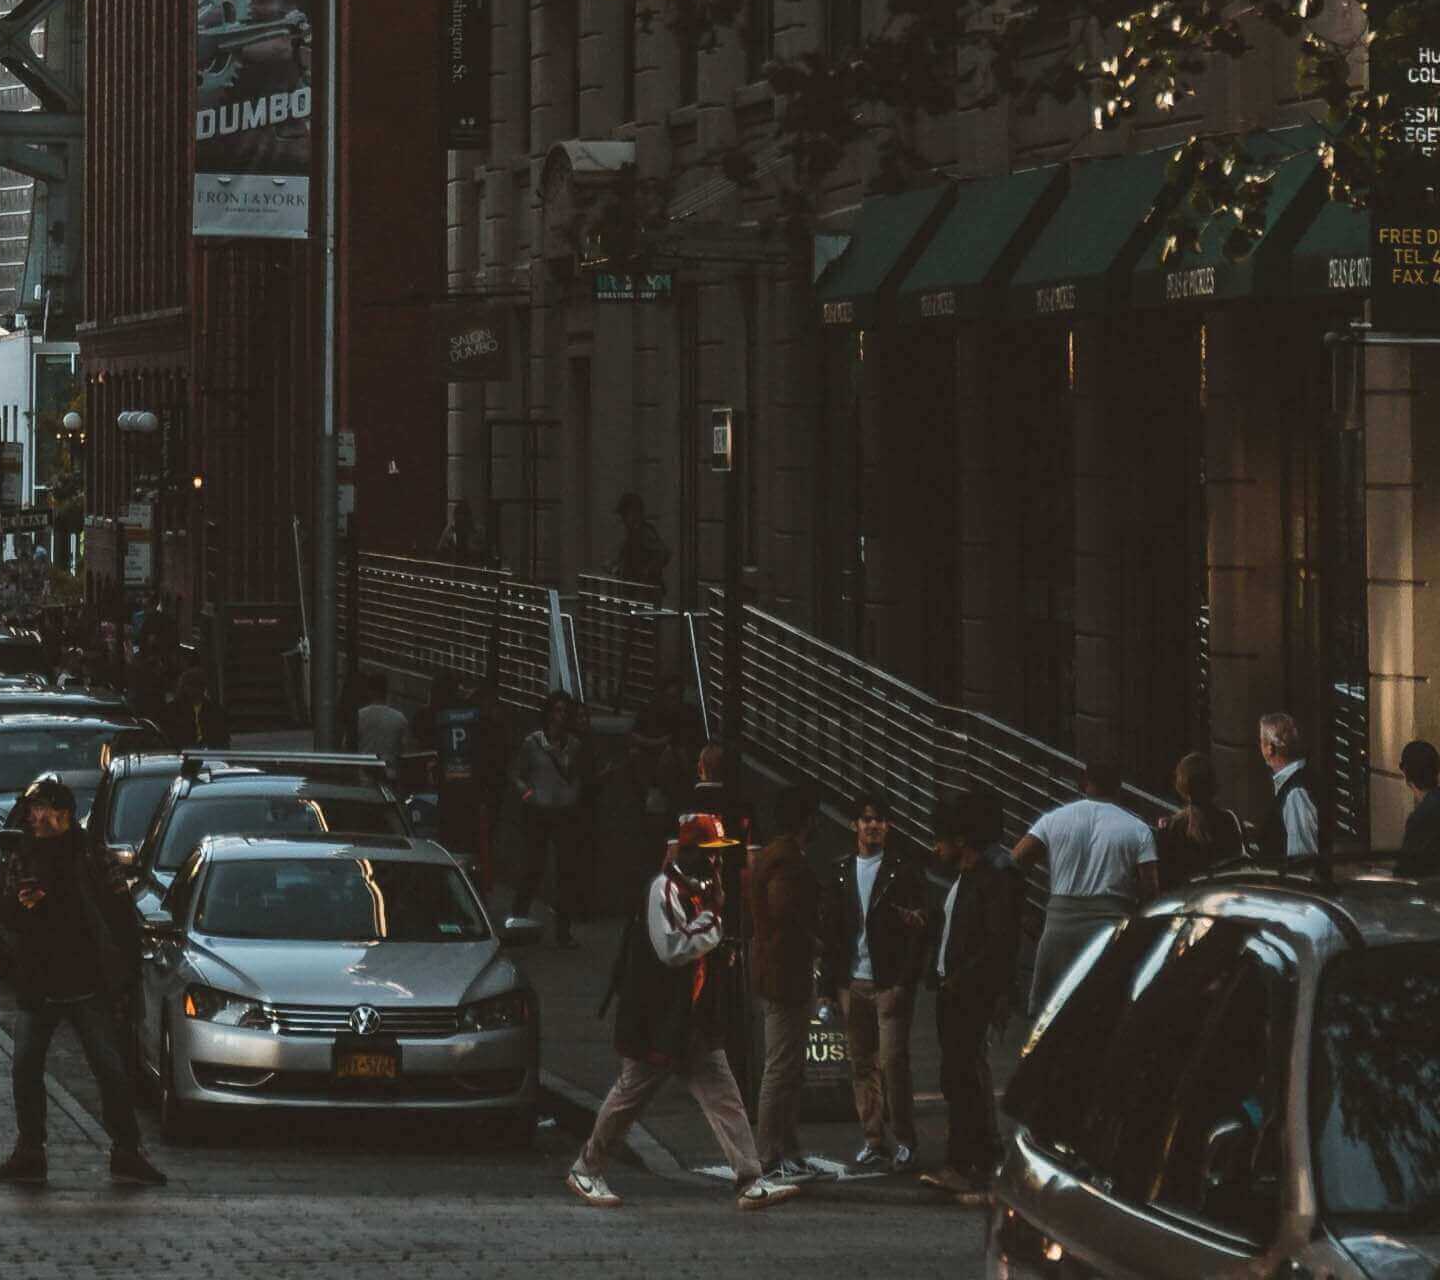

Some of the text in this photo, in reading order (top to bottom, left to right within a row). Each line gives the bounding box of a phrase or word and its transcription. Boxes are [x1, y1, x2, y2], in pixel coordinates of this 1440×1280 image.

[196, 86, 312, 140] DUMBO
[1378, 228, 1422, 244] FREE
[1394, 248, 1430, 265] TEL.
[1391, 268, 1430, 286] FAX.
[451, 727, 467, 751] P
